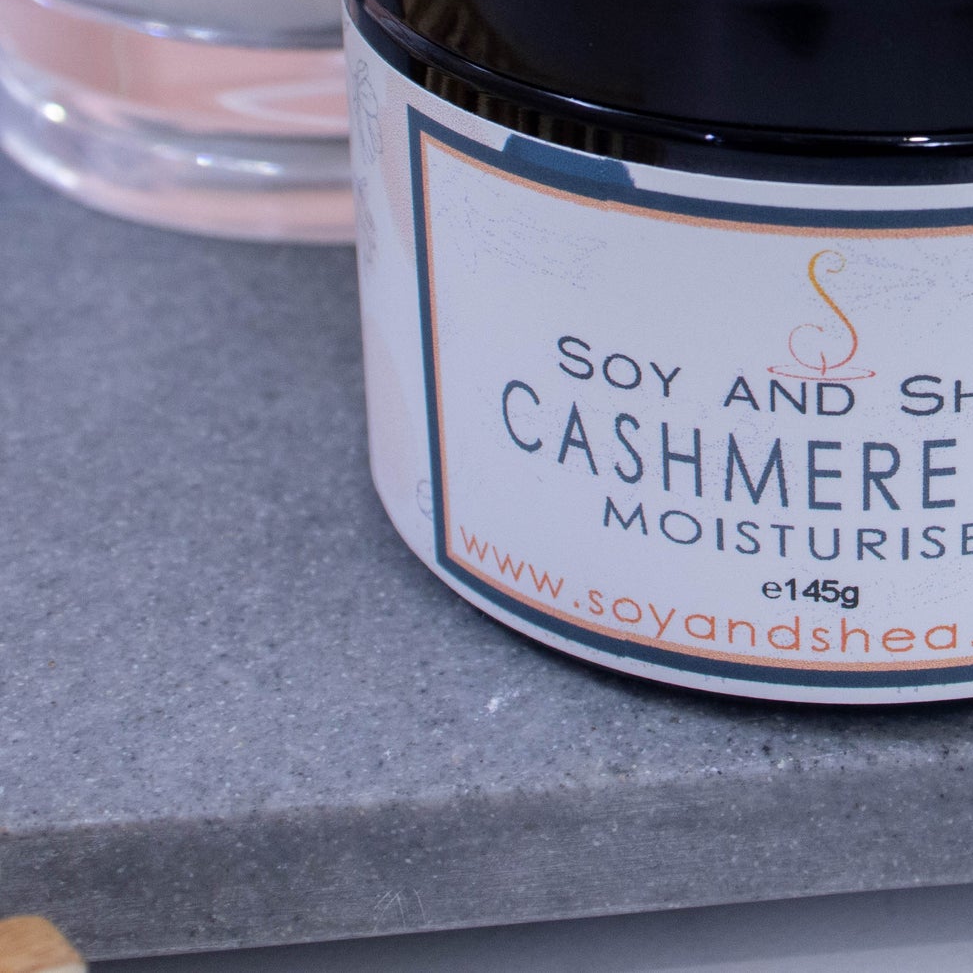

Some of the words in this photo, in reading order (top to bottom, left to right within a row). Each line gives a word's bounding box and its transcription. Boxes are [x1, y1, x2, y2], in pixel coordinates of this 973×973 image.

[556, 334, 682, 398] SOY
[722, 374, 856, 418] AND
[501, 379, 959, 512] CASHMERE
